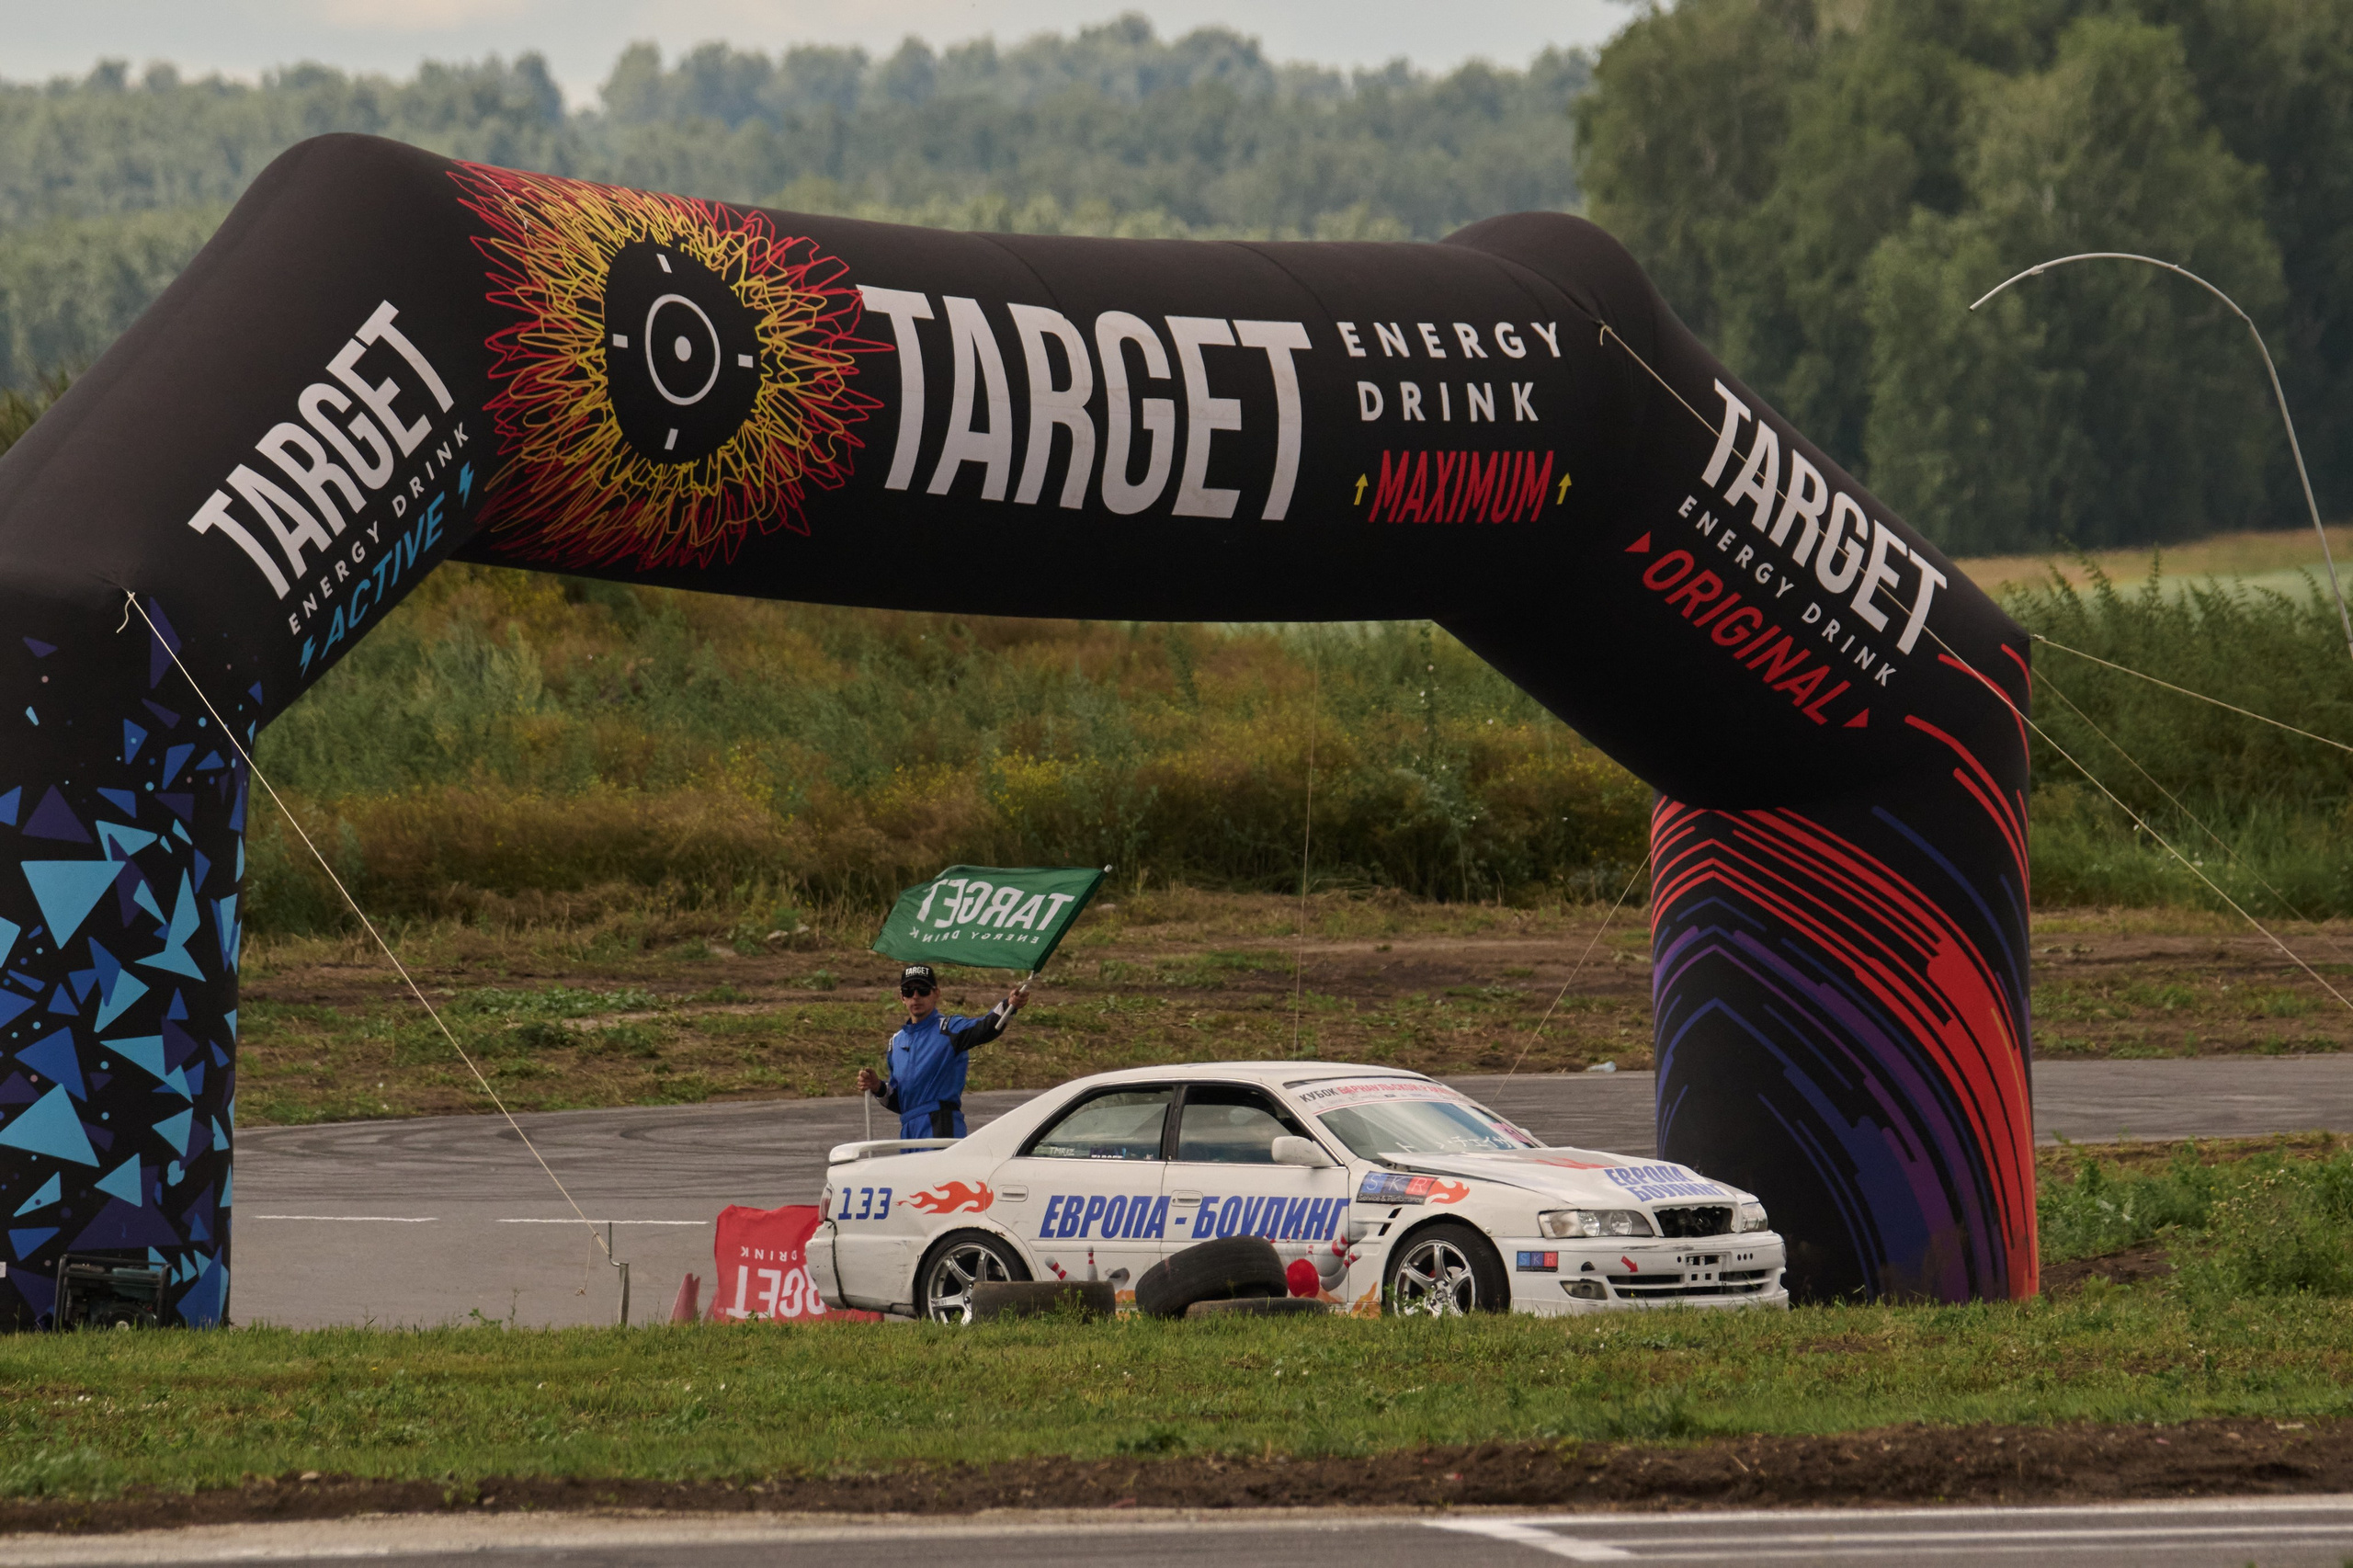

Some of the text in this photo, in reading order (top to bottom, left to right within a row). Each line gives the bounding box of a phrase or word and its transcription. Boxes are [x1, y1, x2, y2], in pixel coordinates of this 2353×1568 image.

[1336, 321, 1563, 359] ENERGY
[856, 283, 1313, 522] TARGET
[1357, 381, 1540, 423] DRINK
[187, 299, 456, 600] TARGET
[1368, 449, 1555, 524] MAXIMUM
[288, 421, 470, 636] ENERGY DRINK
[1701, 378, 1948, 655] TARGET
[320, 490, 447, 661] ACTIVE
[1677, 494, 1898, 687] ENERGY DRINK
[1642, 549, 1852, 726] ORIGINAL
[904, 966, 930, 976] TARGET
[1299, 1087, 1339, 1103] КУБОК
[1366, 1174, 1427, 1193] SKR
[1604, 1165, 1693, 1187] ЕВРОПА
[1625, 1183, 1728, 1203] БОУЛИНГ
[837, 1187, 893, 1221] 133
[1039, 1195, 1172, 1239] ЕВРОПА
[739, 1244, 798, 1263] DRINK
[1519, 1254, 1555, 1266] SKR
